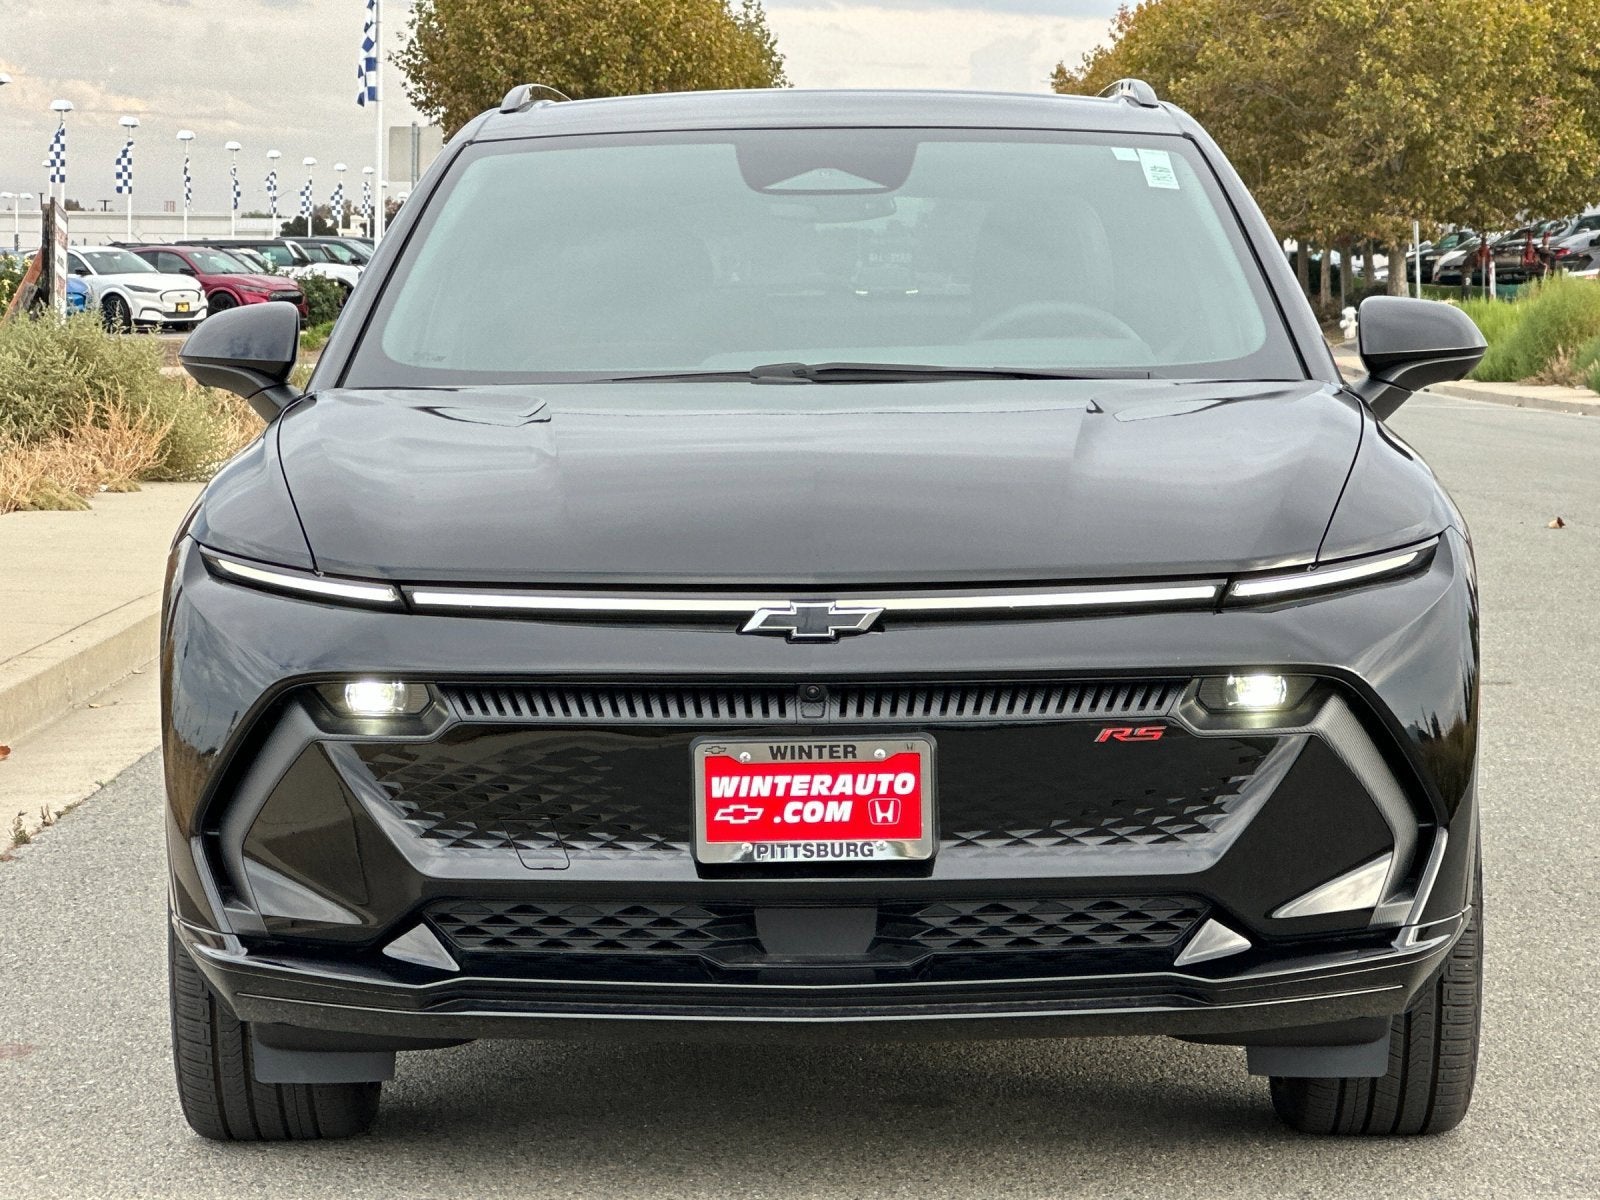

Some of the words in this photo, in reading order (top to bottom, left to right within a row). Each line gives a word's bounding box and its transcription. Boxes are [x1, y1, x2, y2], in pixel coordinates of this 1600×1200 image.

[1094, 726, 1167, 742] RS
[768, 744, 857, 761] WINTER
[711, 773, 916, 798] WINTERAUTO
[773, 801, 853, 824] .COM
[756, 842, 874, 859] PITTSBURG
